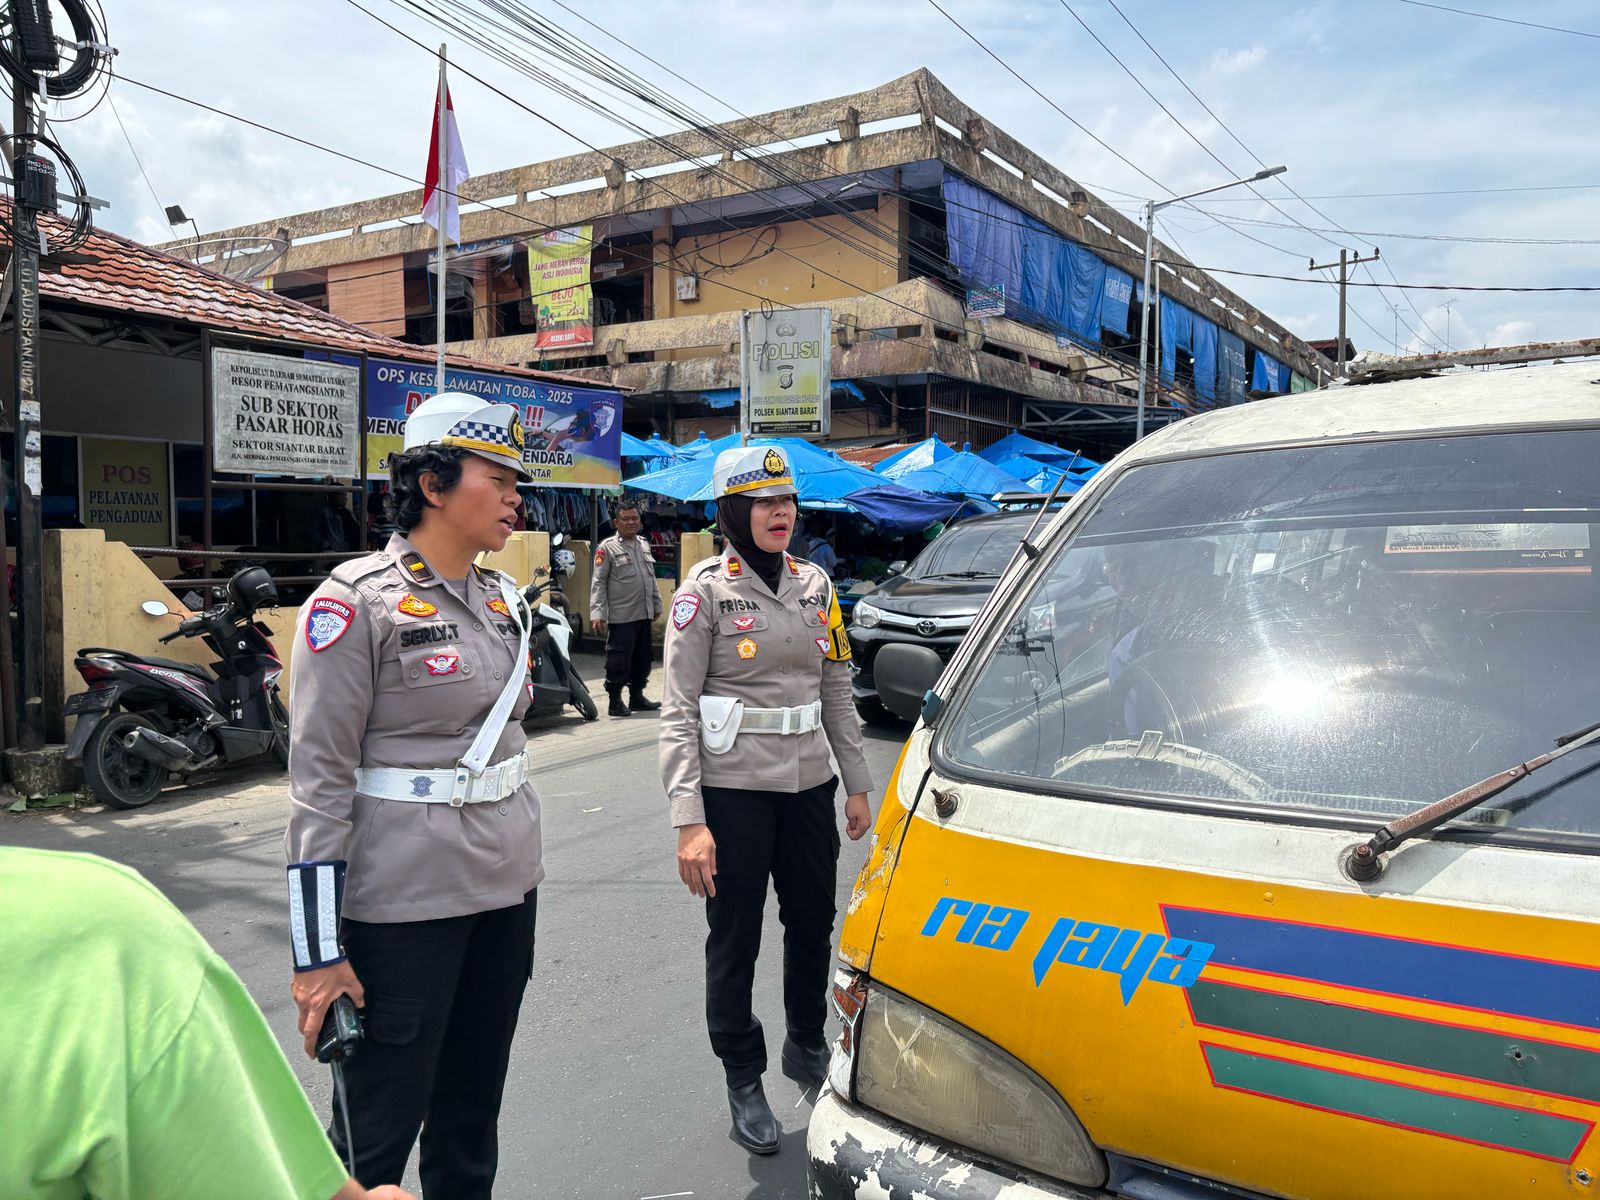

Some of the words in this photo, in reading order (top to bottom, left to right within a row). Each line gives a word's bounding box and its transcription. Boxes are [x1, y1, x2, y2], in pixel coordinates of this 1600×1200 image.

[542, 270, 554, 280] ASLI
[753, 341, 820, 361] POLISI
[231, 364, 269, 378] KEPOLISIAN
[270, 370, 295, 381] DAERAH
[295, 373, 327, 384] SUMATERA
[231, 376, 262, 390] RESOR
[264, 380, 346, 398] PEMATANGSIANTAR
[377, 367, 405, 384] OPS
[409, 371, 501, 395] KESEAMATAN
[505, 384, 536, 400] TOBA
[547, 390, 573, 405] 2025
[241, 395, 273, 413] SUB
[277, 399, 339, 420] SEKTOR
[754, 408, 775, 417] POLSEK
[776, 407, 799, 416] SIANTAR
[800, 407, 818, 415] BARAT
[236, 414, 288, 434] PASAR
[293, 419, 344, 439] HORAS
[232, 439, 274, 451] SEKTOR
[275, 443, 316, 454] SIANTAR
[317, 446, 346, 455] BARAT
[102, 464, 151, 484] POS
[89, 490, 160, 506] PELAYANAN
[89, 508, 163, 524] PENGADUAN
[719, 599, 761, 614] FRISKA
[400, 624, 460, 647] SERLY.T
